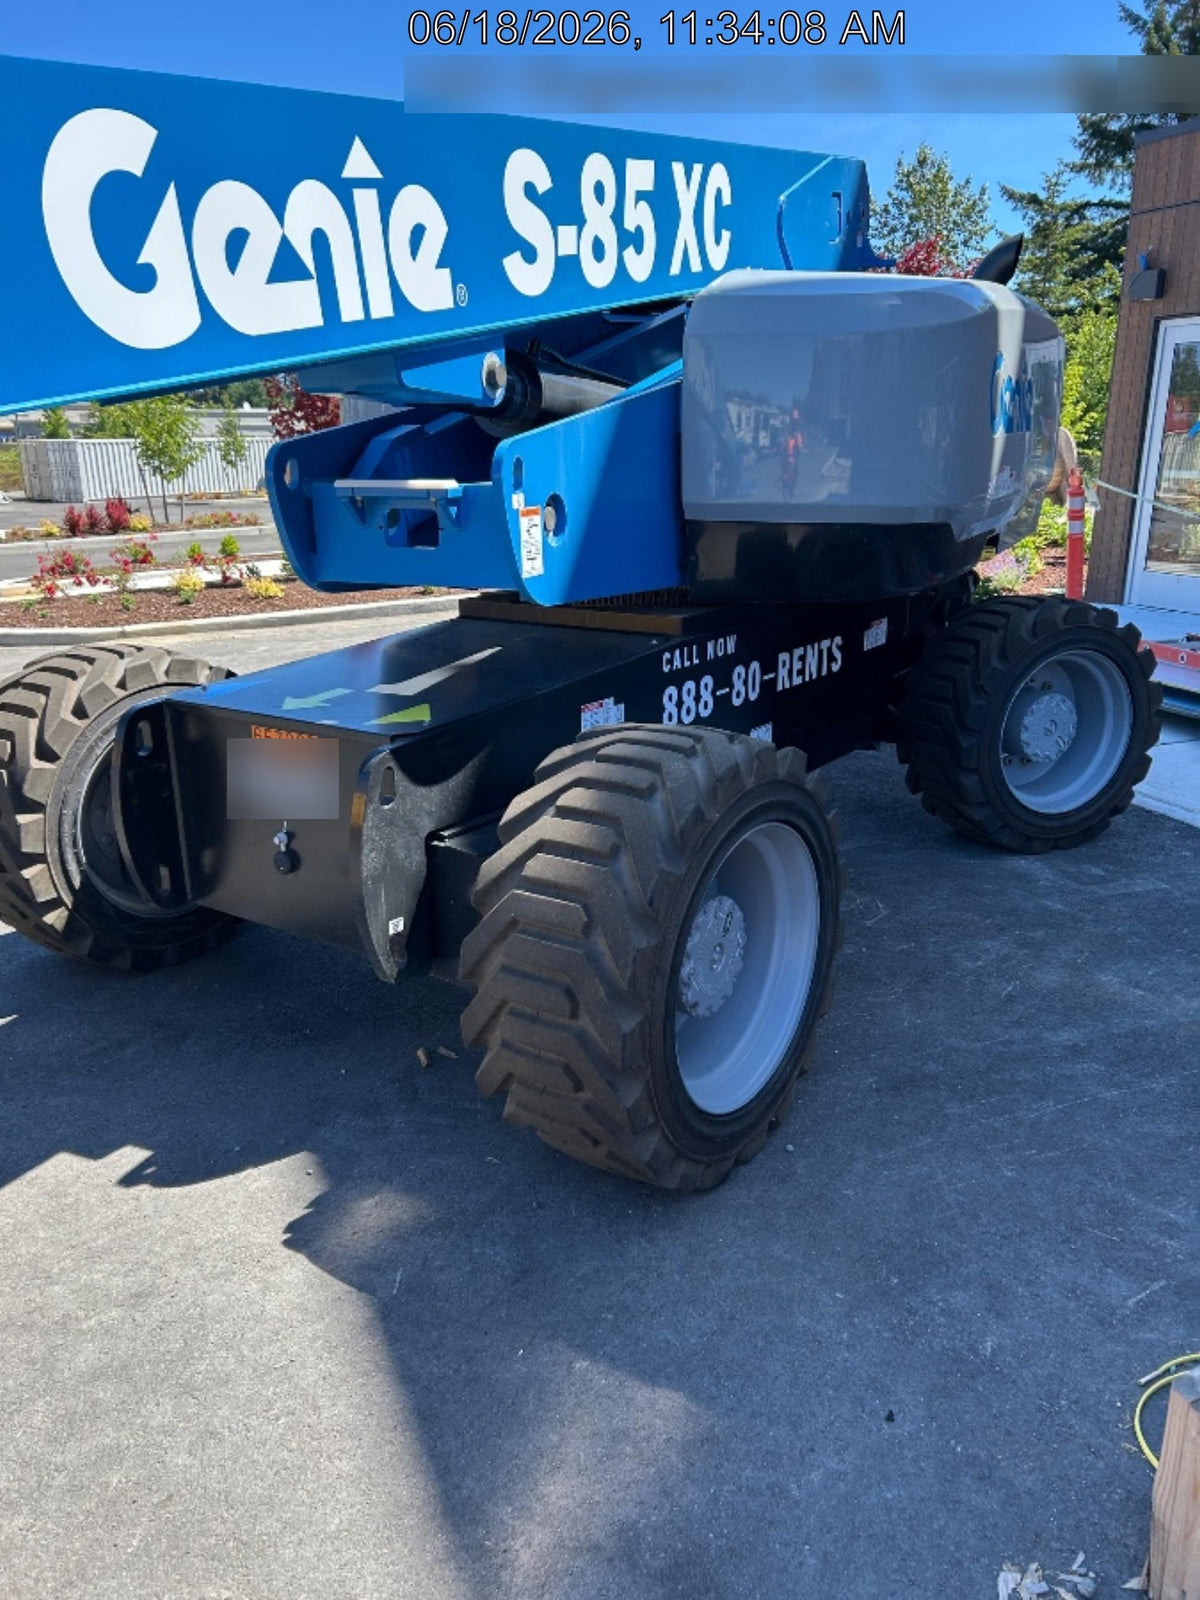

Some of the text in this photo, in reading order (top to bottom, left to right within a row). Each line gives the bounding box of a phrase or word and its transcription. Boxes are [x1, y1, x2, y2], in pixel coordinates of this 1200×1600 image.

[41, 107, 455, 350] Genie
[502, 147, 733, 297] S-85 XC
[662, 634, 738, 673] CALL NOW
[662, 635, 843, 726] 888-80-RENTS
